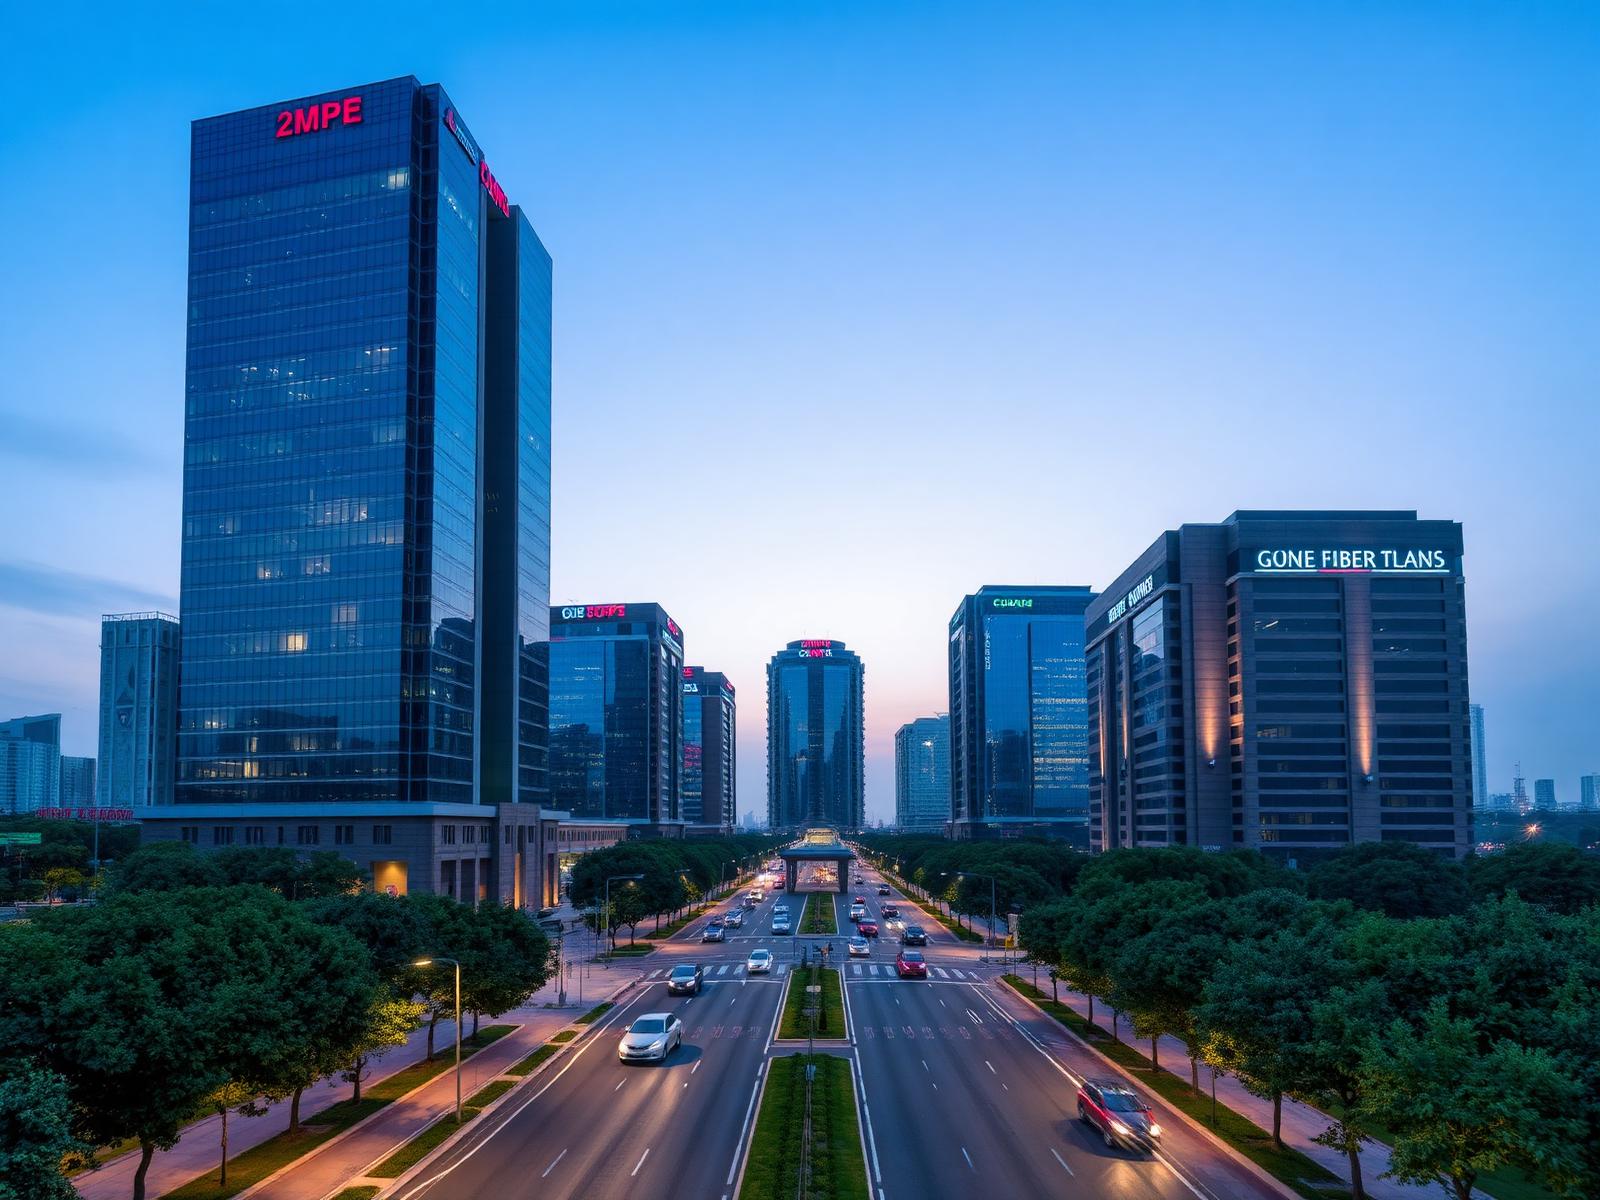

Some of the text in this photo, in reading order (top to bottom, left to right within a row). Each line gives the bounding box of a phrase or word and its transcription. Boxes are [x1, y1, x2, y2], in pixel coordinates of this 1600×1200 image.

[275, 96, 362, 138] 2MPE
[1257, 550, 1446, 568] GONE FIBER TLANS
